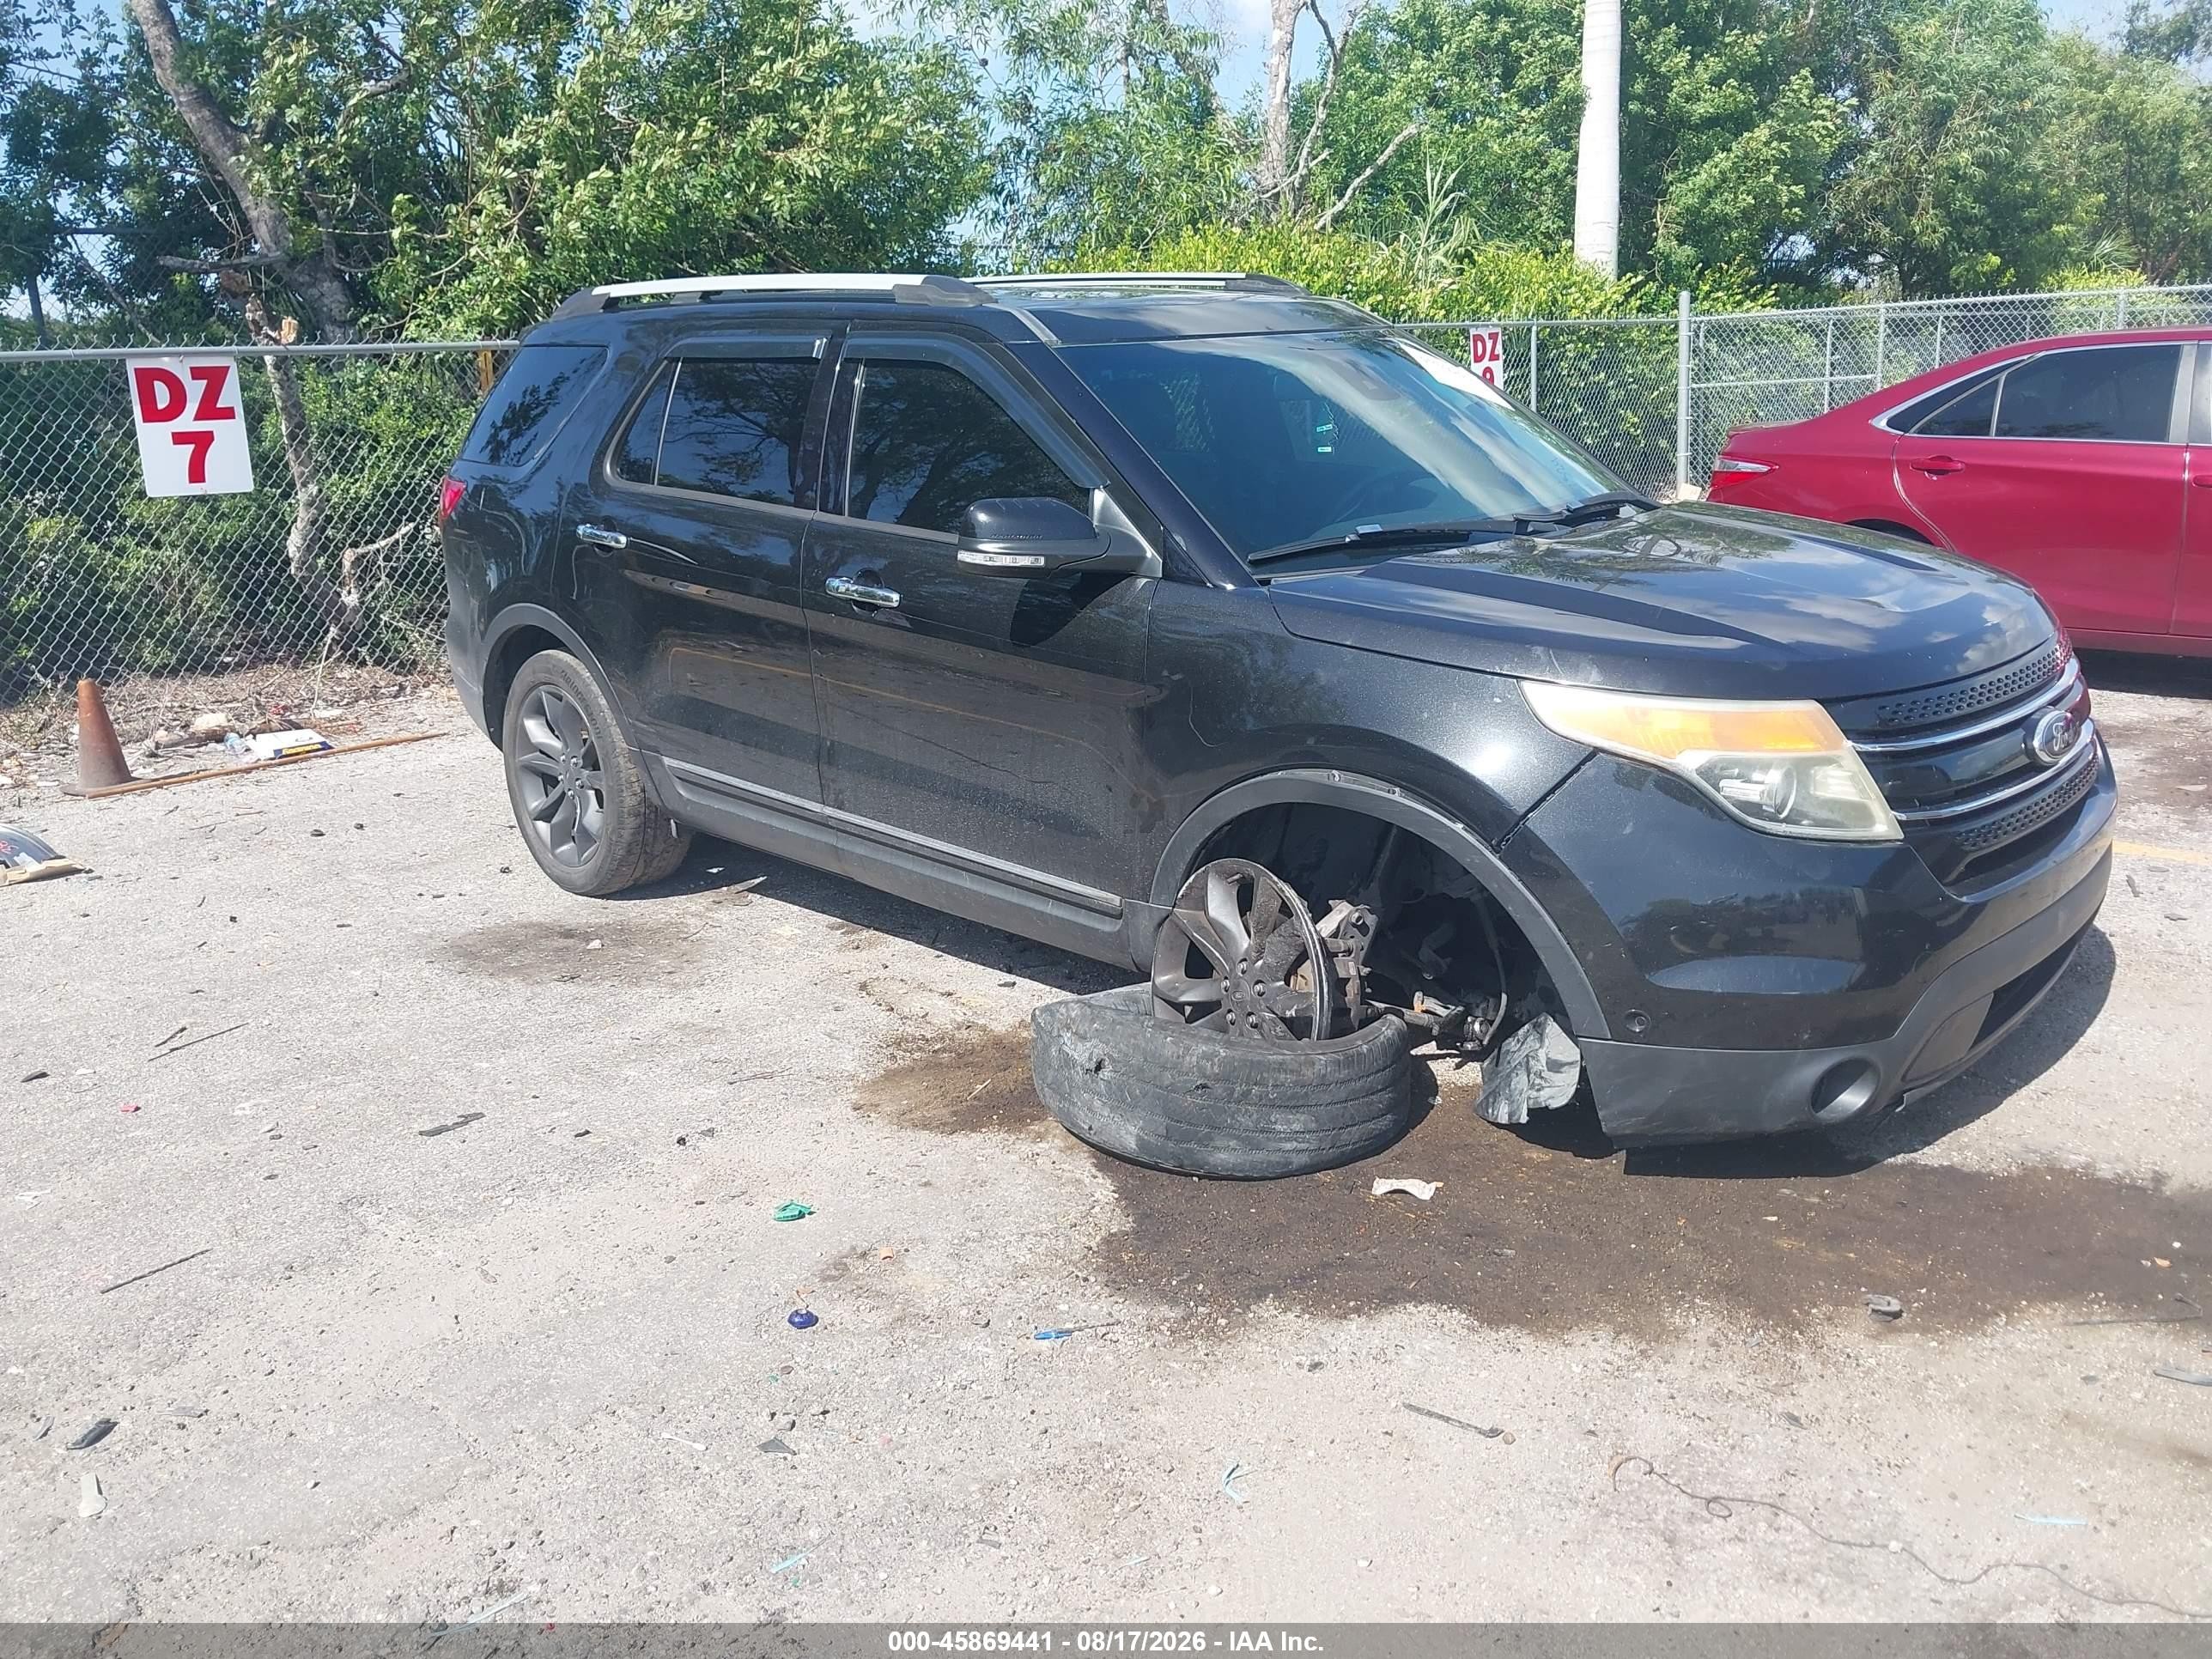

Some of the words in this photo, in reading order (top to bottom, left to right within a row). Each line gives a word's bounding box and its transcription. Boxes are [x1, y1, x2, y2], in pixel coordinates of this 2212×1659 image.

[1472, 331, 1501, 363] DZ
[133, 365, 237, 424] DZ
[171, 430, 216, 484] 7
